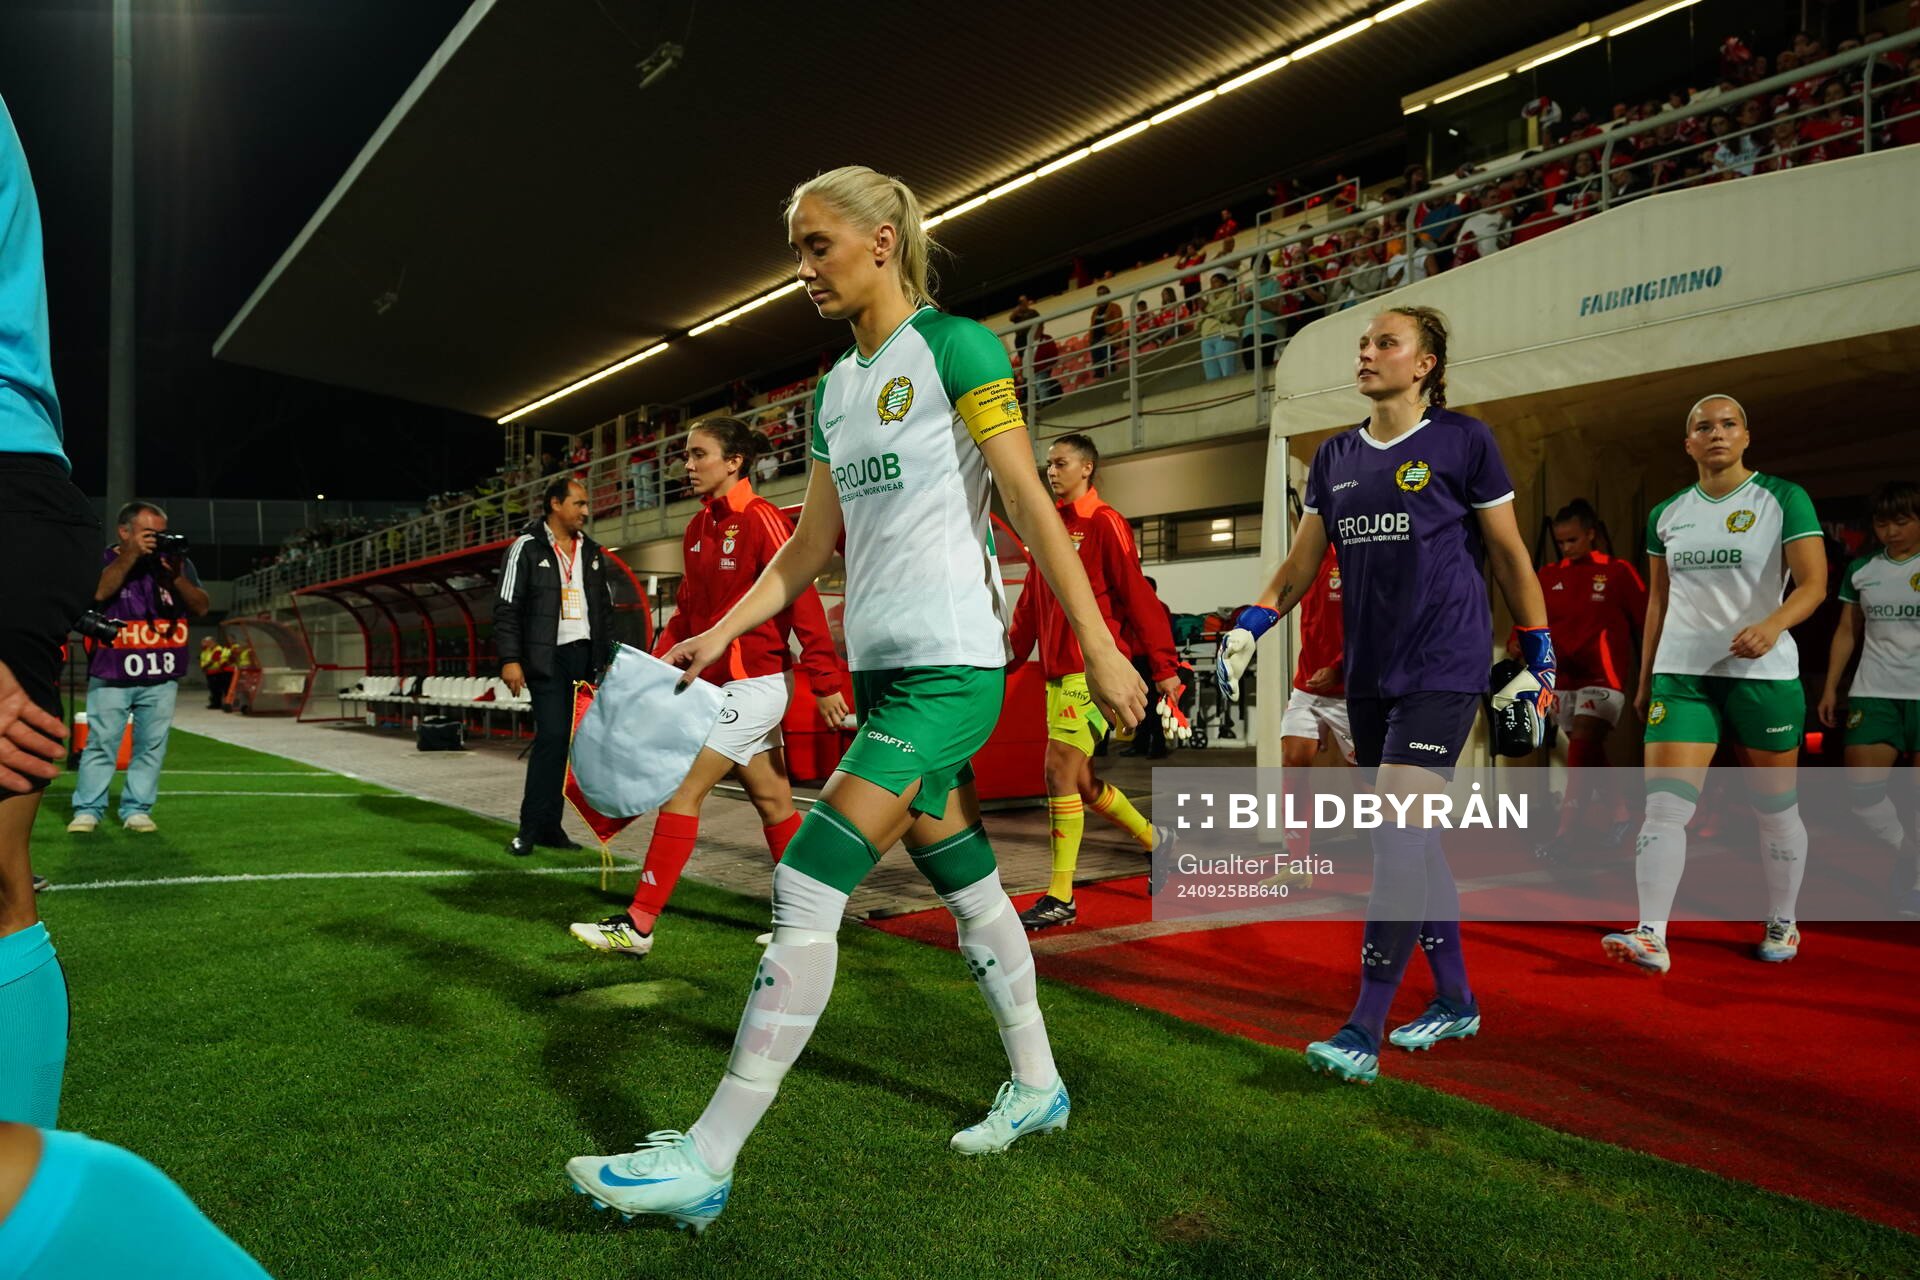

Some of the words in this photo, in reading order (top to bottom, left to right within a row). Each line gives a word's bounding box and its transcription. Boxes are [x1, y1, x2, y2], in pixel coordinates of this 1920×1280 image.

[1580, 265, 1723, 317] FABRIGIMNO
[863, 481, 904, 496] WORKWEAR
[1332, 481, 1352, 492] CRAFT
[1372, 534, 1410, 542] WORKWEAR
[1673, 549, 1742, 567] PROJOB
[112, 622, 188, 645] HOTO
[124, 652, 175, 677] 018
[867, 730, 905, 748] CRAFT
[1409, 741, 1440, 752] CRAFT
